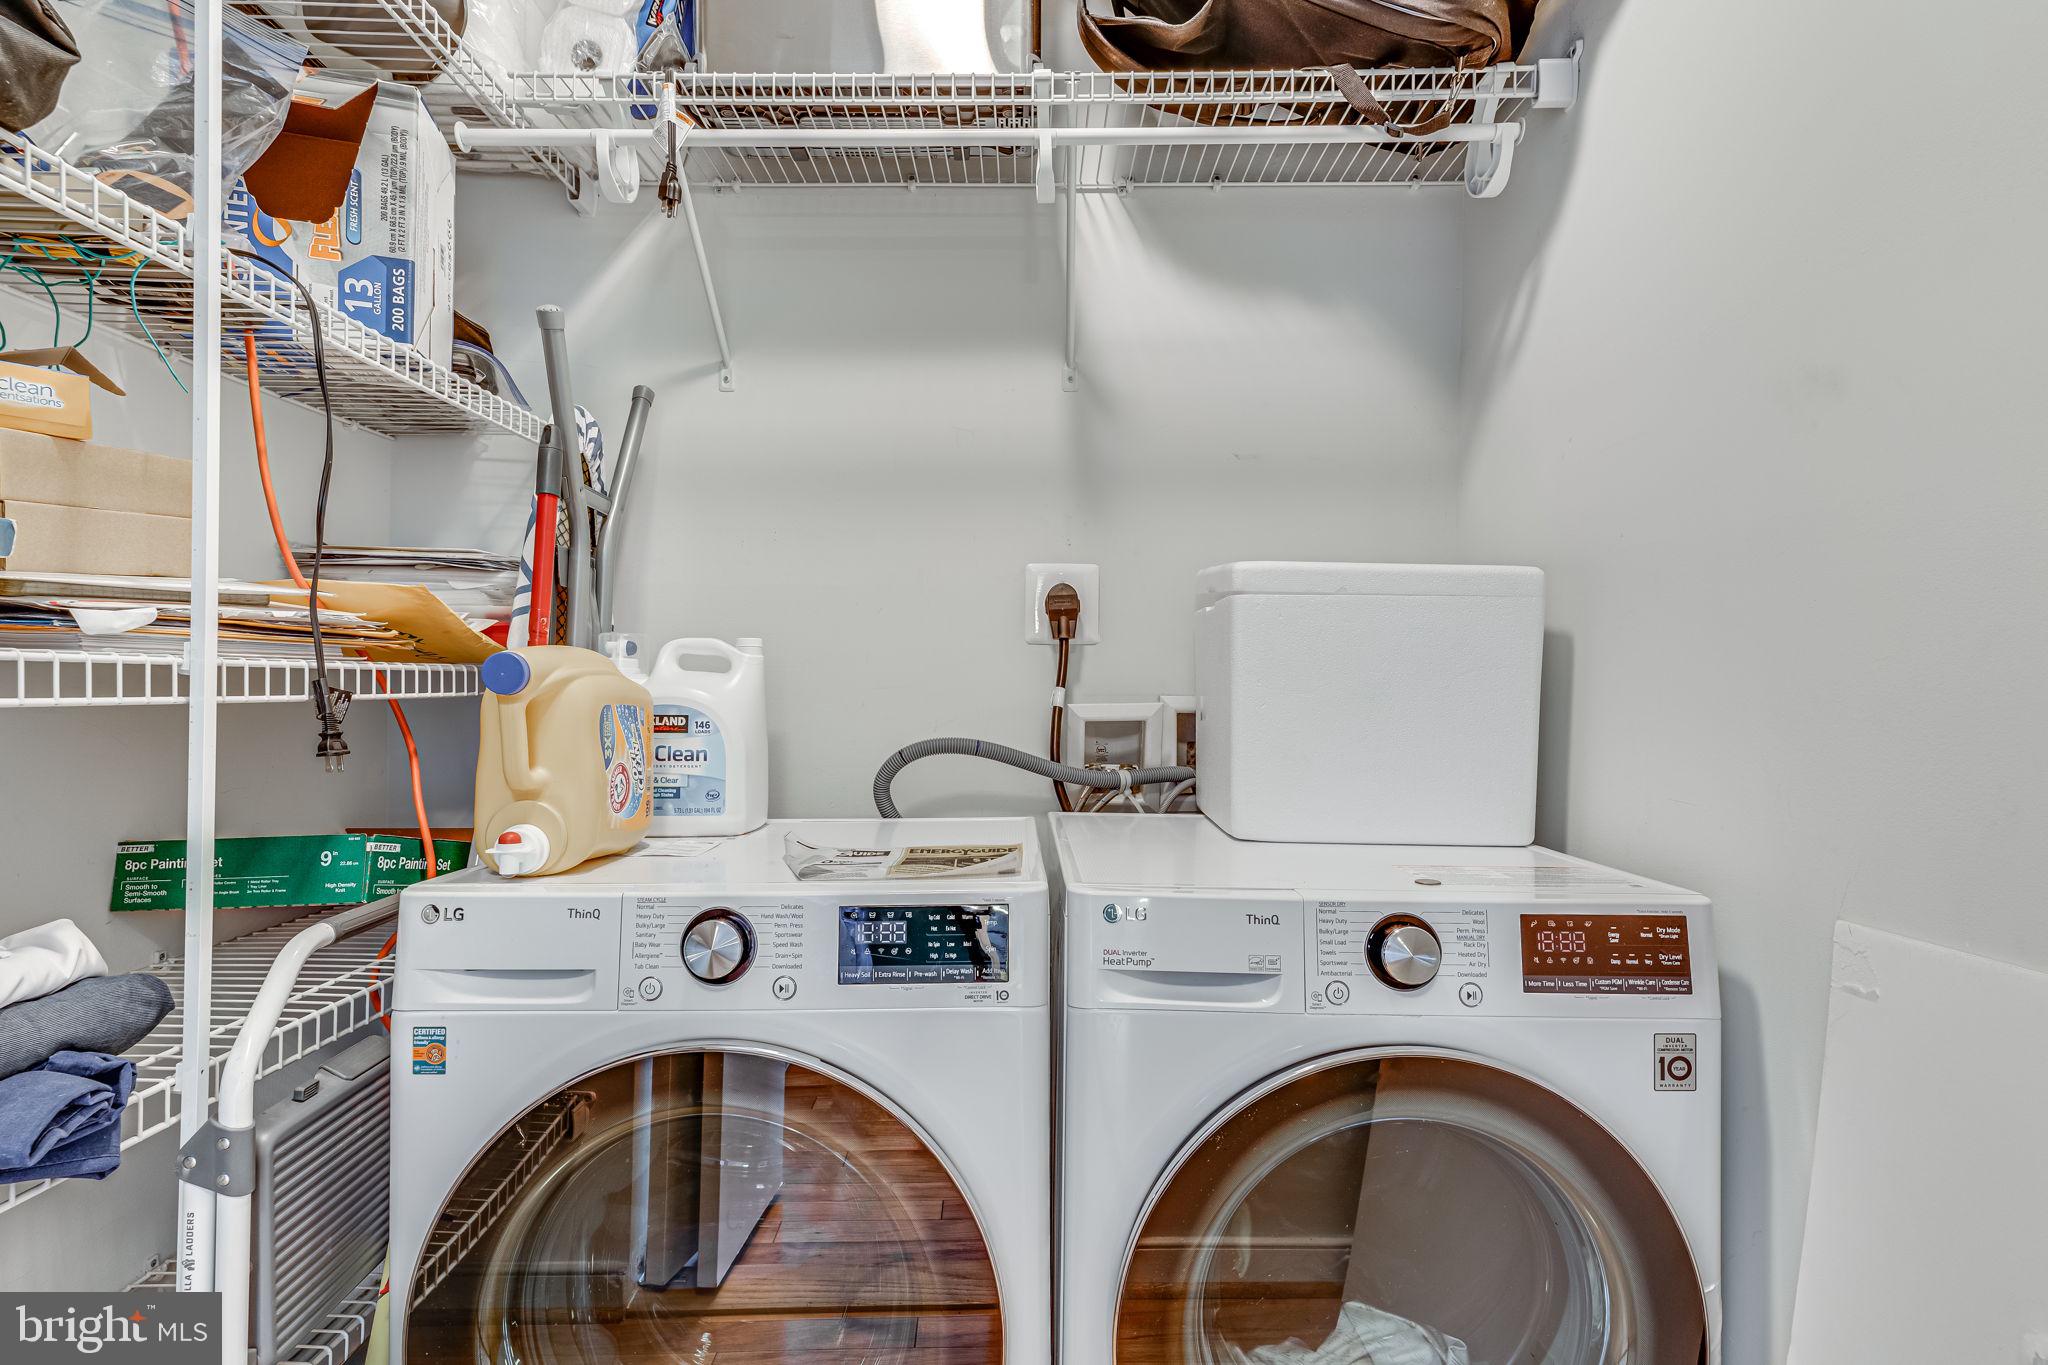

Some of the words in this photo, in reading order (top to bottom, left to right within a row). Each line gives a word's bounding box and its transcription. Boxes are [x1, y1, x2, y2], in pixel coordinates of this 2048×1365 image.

[391, 126, 399, 144] (BODY)
[381, 154, 389, 167] GAL)
[381, 168, 389, 177] (13
[350, 180, 358, 205] SCENT
[380, 195, 388, 210] BAGS
[349, 206, 359, 232] FRESH
[381, 211, 389, 222] 200
[308, 206, 342, 262] FLE
[391, 268, 405, 305] BAGS
[344, 278, 374, 312] 13
[373, 282, 382, 316] GALLON
[392, 309, 404, 332] 200
[0, 377, 52, 397] clean
[695, 721, 710, 729] 146
[655, 745, 708, 762] Clean
[125, 859, 147, 872] 8pc
[151, 858, 187, 870] Painti
[320, 851, 332, 866] 9
[377, 856, 396, 871] 8pc
[437, 859, 451, 870] Set
[444, 907, 464, 921] LG
[568, 908, 601, 920] ThinQ
[1125, 906, 1147, 921] LG
[1246, 914, 1280, 926] ThinQ
[1658, 1056, 1692, 1081] 10
[186, 1212, 195, 1256] LADDERS
